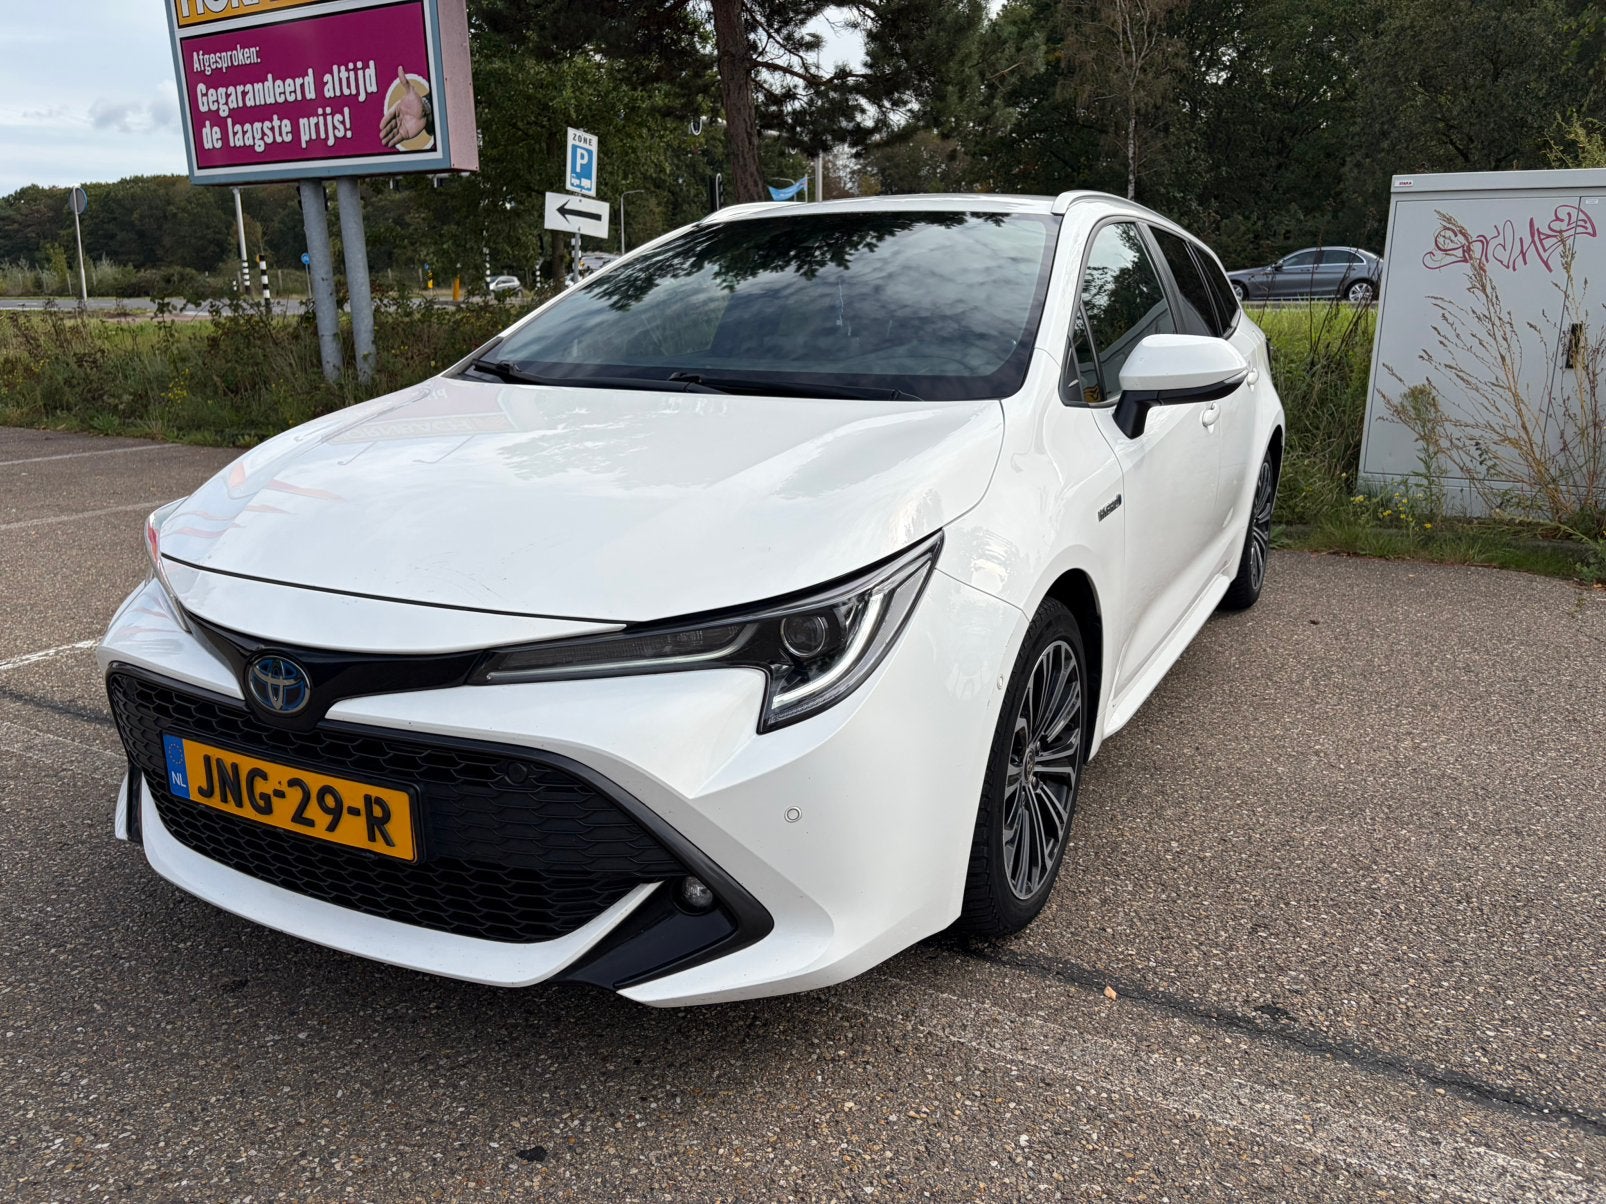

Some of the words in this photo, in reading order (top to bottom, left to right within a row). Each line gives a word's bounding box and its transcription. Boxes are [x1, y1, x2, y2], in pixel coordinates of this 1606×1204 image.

[193, 44, 261, 75] Afgesproken:
[196, 68, 316, 117] Gegarandeerd
[323, 60, 378, 102] altijd
[202, 120, 223, 150] de
[227, 114, 293, 152] laagste
[299, 107, 352, 148] prijs!
[572, 133, 593, 147] ZONE
[575, 148, 589, 172] P
[171, 771, 187, 788] NL
[198, 754, 395, 847] JNG-29-R
